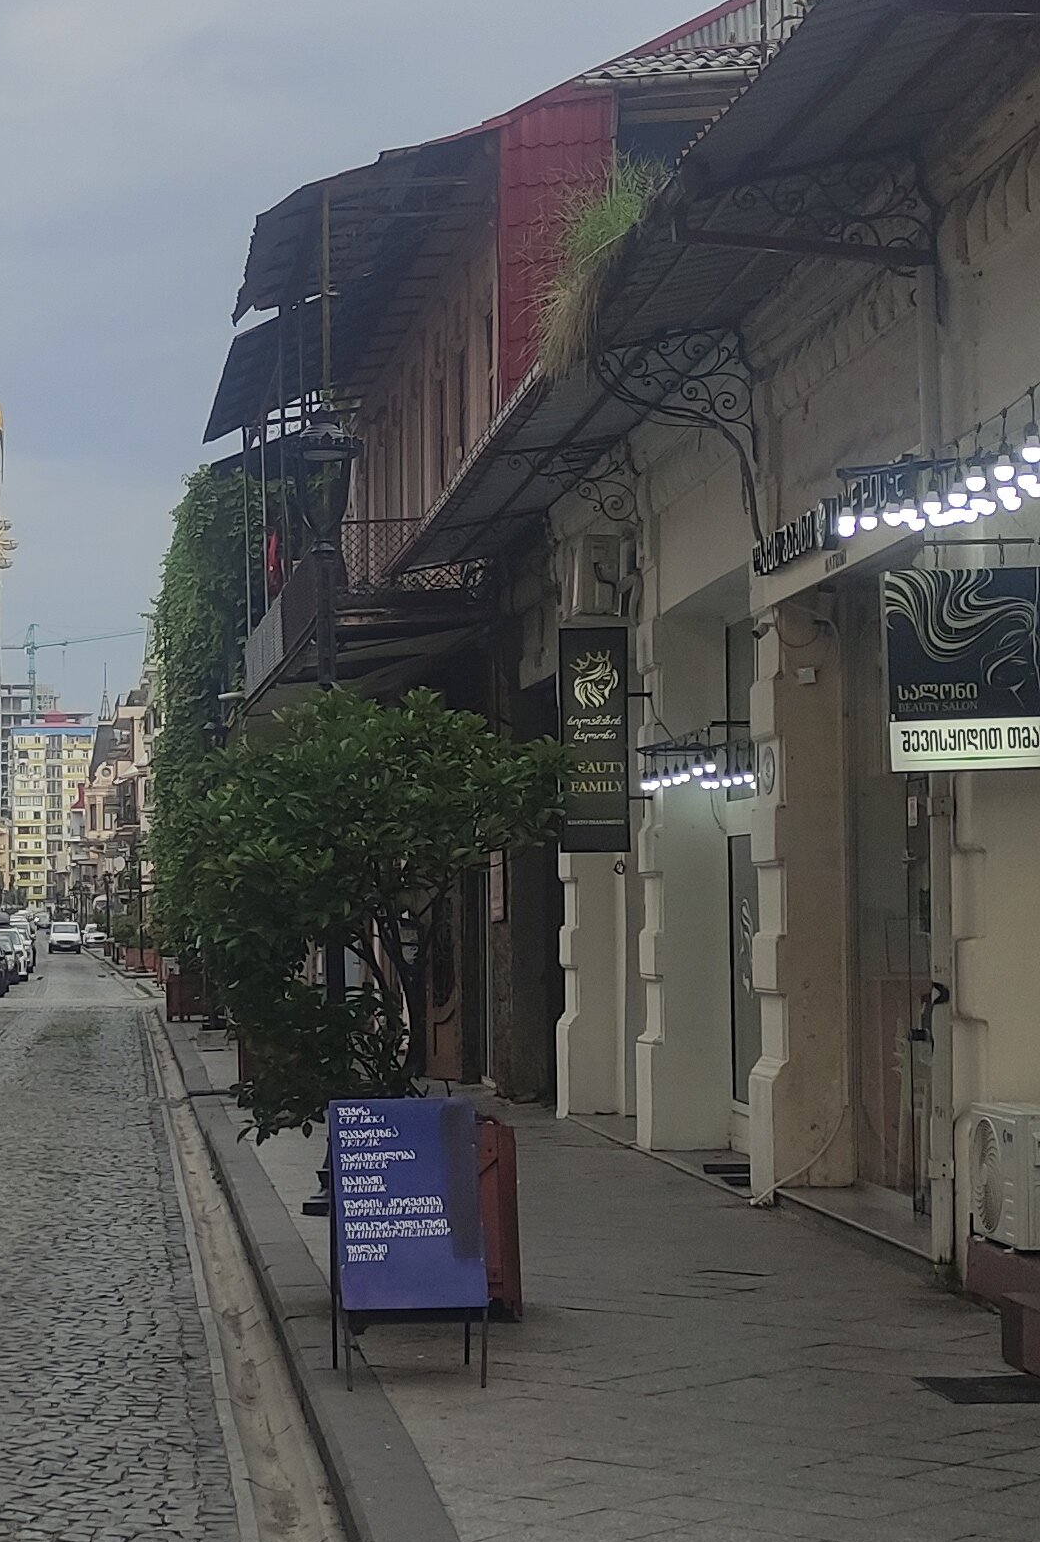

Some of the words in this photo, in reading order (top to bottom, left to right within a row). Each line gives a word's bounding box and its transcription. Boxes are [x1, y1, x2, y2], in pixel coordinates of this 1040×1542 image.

[897, 682, 978, 700] სალონი
[898, 702, 940, 712] BEAUTY
[942, 701, 978, 711] SALON
[901, 727, 1003, 752] შევისყიდით
[1007, 726, 1040, 749] თმა
[576, 761, 625, 774] EAUTY
[570, 780, 625, 793] FAMILY
[343, 1184, 387, 1193] МАКИЯЖ
[344, 1205, 403, 1217] КОРРЕКЦИЯ
